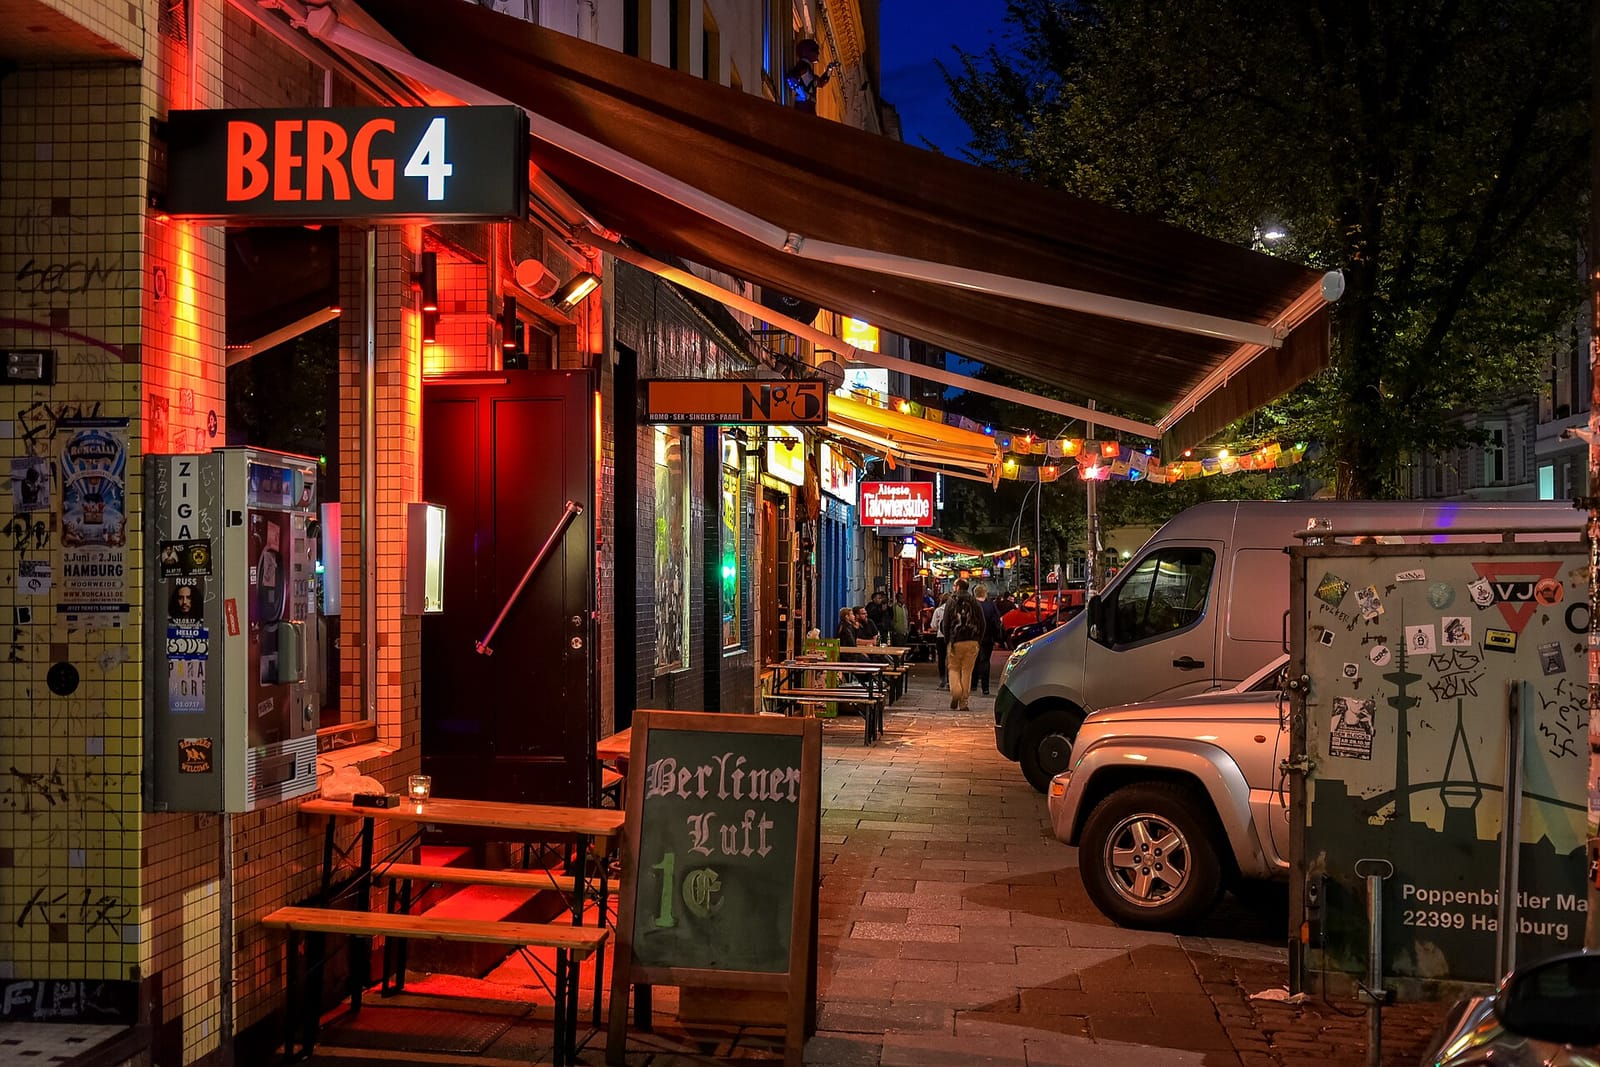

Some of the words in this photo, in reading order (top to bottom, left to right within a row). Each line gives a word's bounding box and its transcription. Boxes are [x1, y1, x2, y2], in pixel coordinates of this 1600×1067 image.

[226, 119, 396, 201] BERG
[404, 117, 453, 201] 4
[98, 552, 123, 562] 2.Juli
[63, 564, 123, 577] HAMBURG
[175, 577, 197, 586] RUSS
[175, 629, 200, 637] HELLO
[646, 752, 800, 802] Berliner
[687, 809, 775, 858] Luft
[1402, 884, 1550, 910] Poppenbtler
[1403, 910, 1465, 929] 22399
[1471, 913, 1569, 940] Haburg
